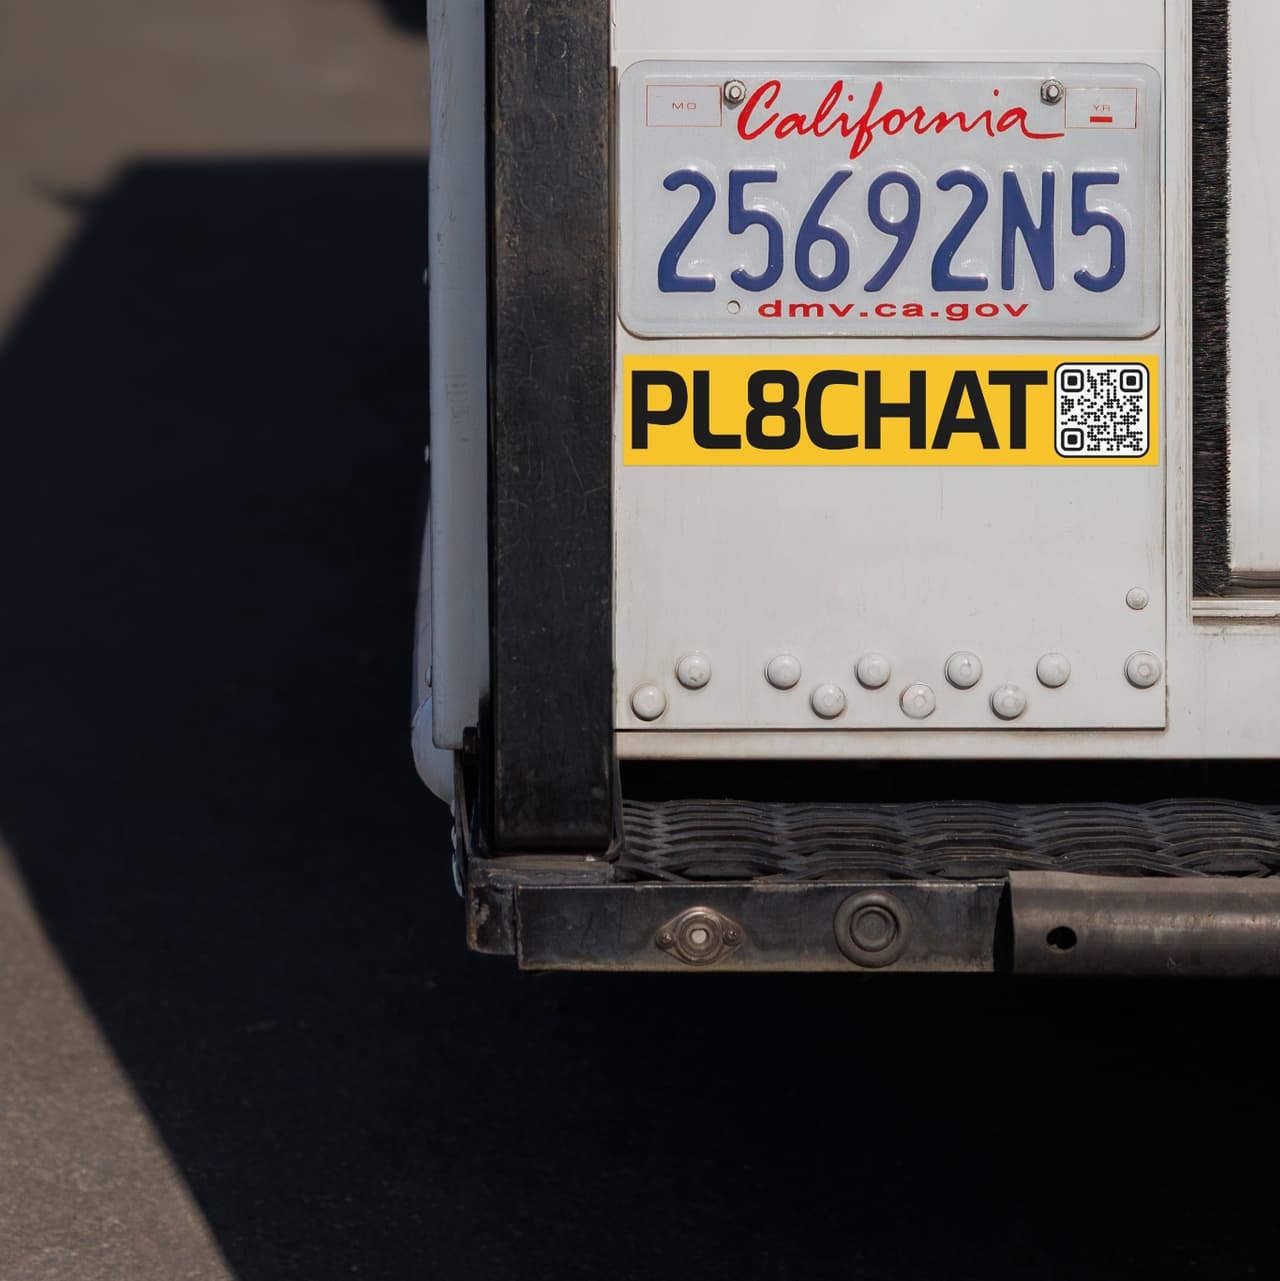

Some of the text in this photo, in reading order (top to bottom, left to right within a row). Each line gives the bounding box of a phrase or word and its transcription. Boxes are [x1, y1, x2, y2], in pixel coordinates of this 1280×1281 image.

[671, 101, 697, 110] MO
[736, 80, 1065, 160] California
[657, 169, 1125, 293] 25692N5
[757, 299, 1029, 322] dmv.ca.gov
[631, 370, 1048, 450] PL8CHAT
